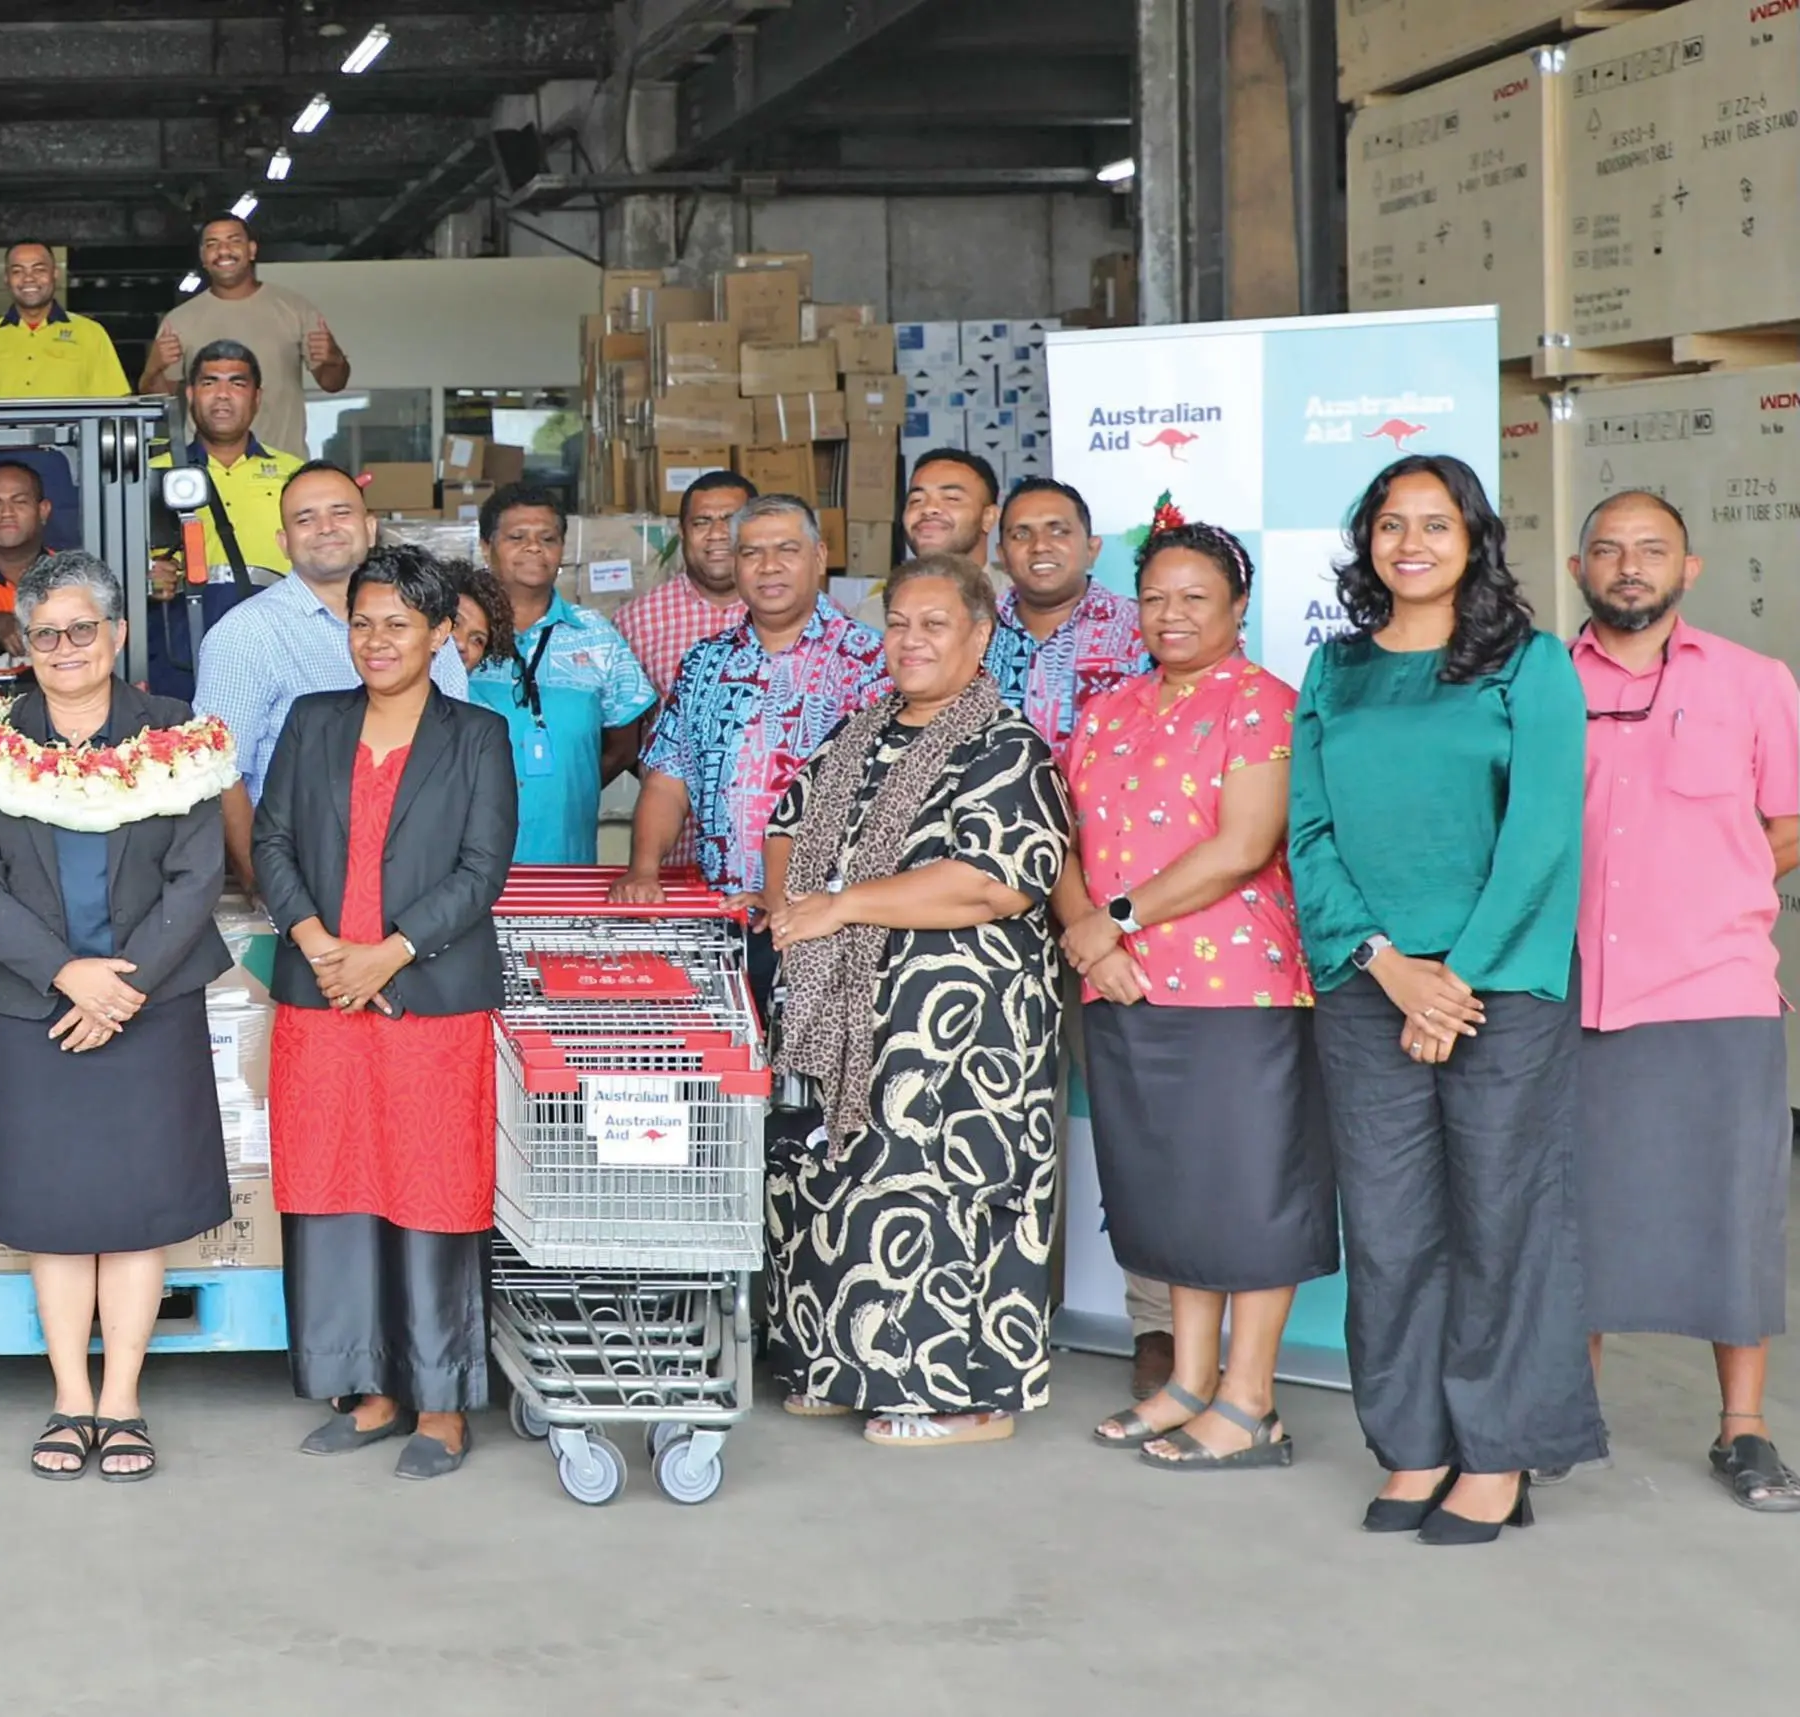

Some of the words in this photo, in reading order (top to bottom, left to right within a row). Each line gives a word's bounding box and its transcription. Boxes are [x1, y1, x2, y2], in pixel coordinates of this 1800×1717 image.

[1088, 403, 1221, 426] Australian
[1304, 393, 1454, 418] Australian
[1088, 430, 1130, 451] Aid
[1304, 420, 1352, 442] Aid
[1745, 504, 1770, 521] TUBE
[595, 1090, 668, 1103] Australian
[605, 1114, 682, 1127] Australian
[605, 1129, 630, 1141] Aid
